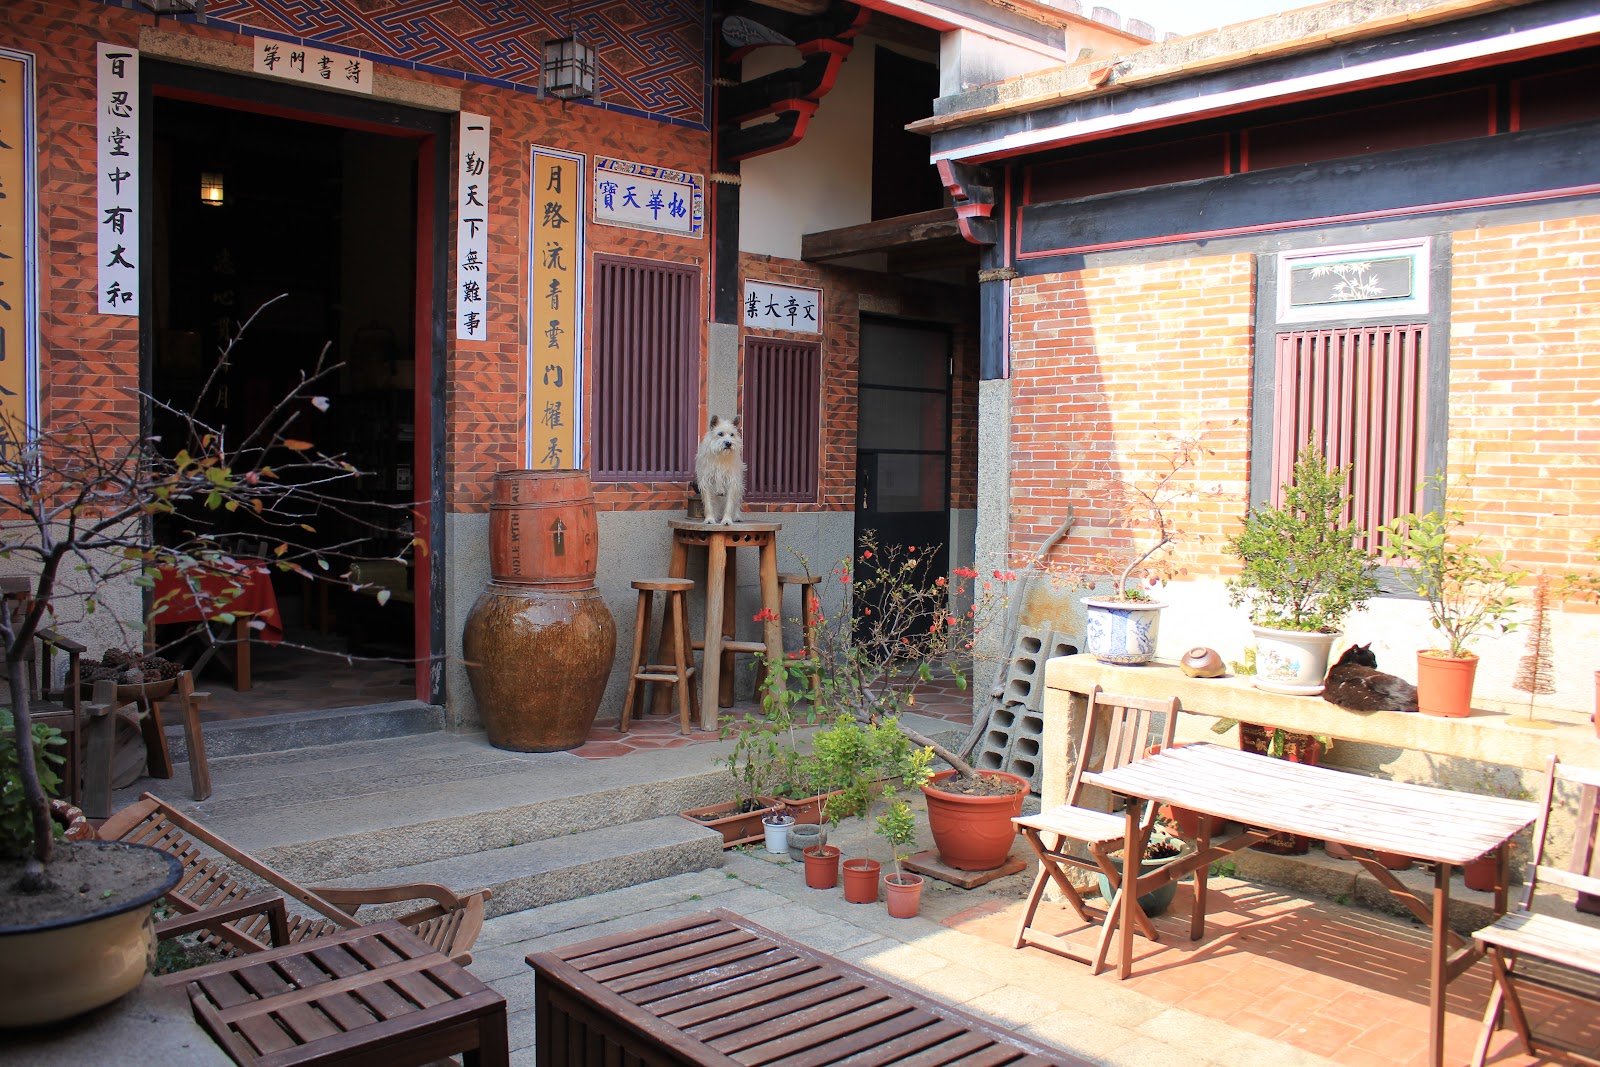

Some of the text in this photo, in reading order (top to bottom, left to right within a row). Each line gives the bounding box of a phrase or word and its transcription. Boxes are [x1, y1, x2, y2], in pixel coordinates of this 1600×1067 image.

[102, 53, 135, 308] 百忍堂中有太和
[461, 126, 485, 335] 一勤天下無難事
[511, 480, 521, 576] NDLE WITH ARE
